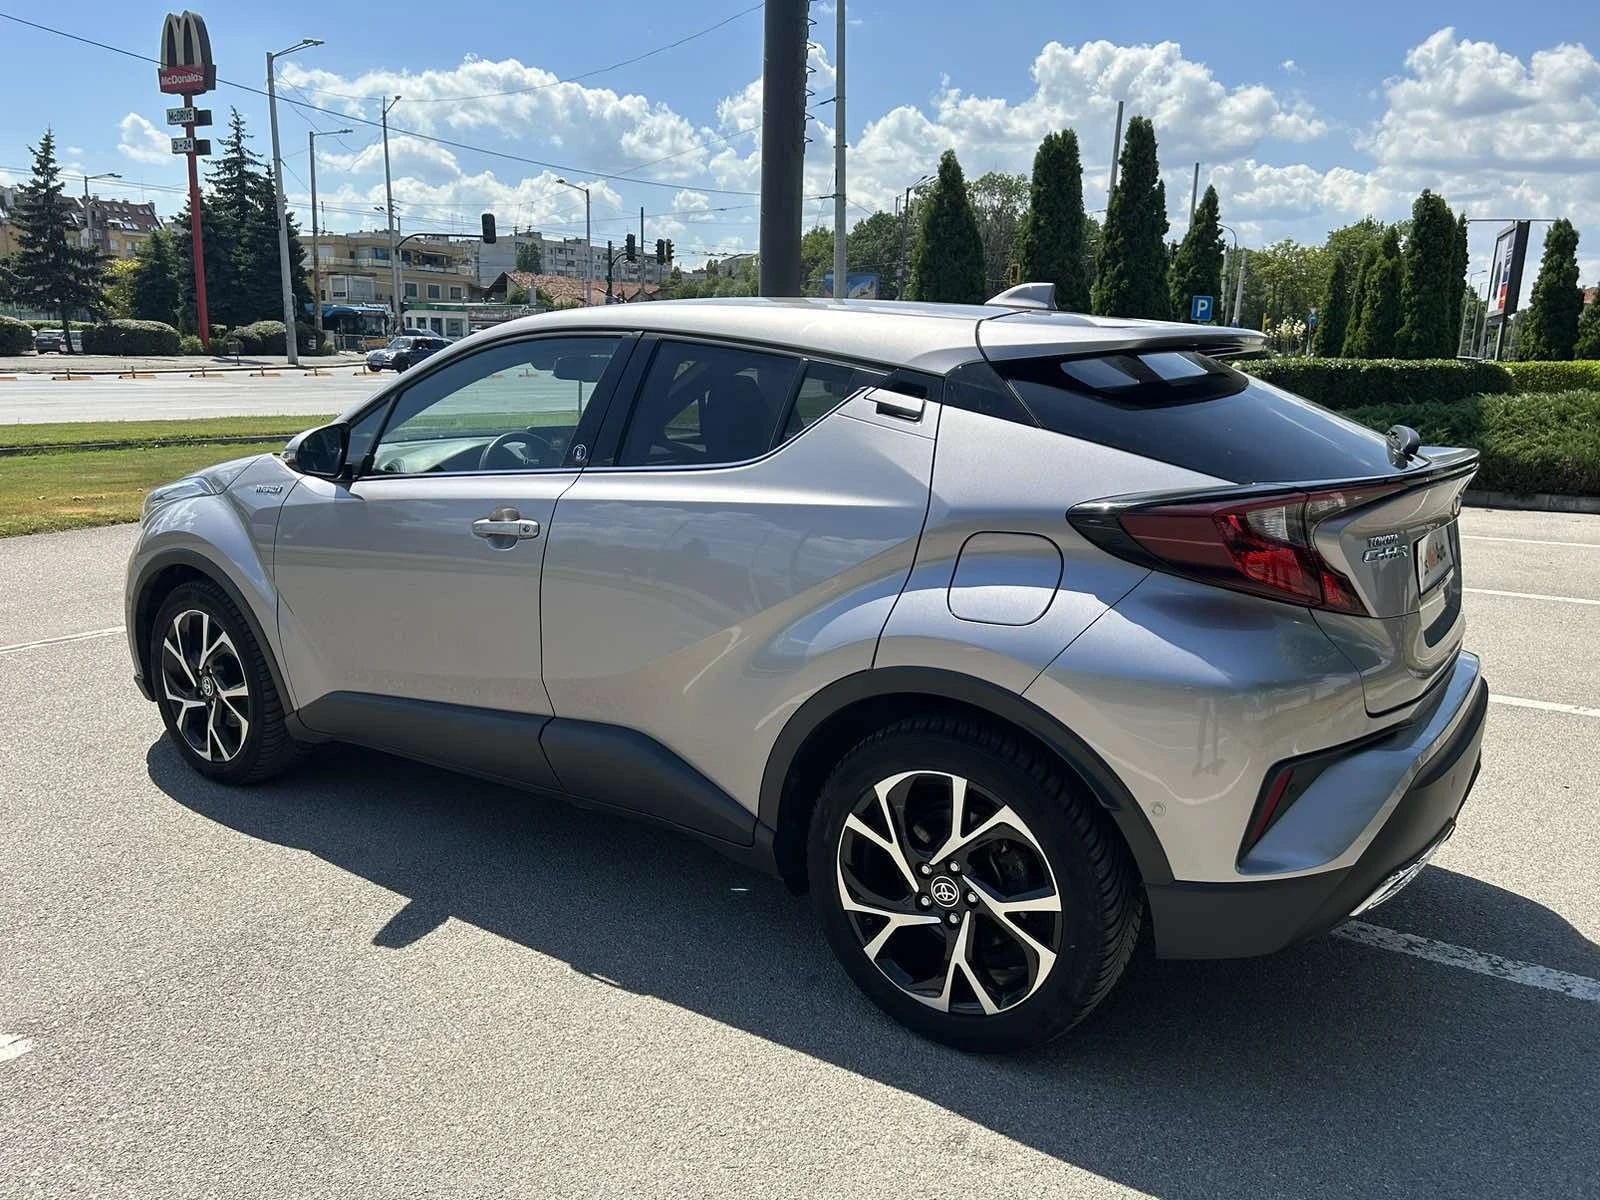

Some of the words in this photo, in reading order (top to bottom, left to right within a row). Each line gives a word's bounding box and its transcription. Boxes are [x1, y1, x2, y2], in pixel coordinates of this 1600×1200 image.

[168, 109, 193, 122] McDRIVE
[1196, 299, 1209, 317] P
[1368, 533, 1400, 548] TOYOTA
[1362, 545, 1409, 563] C-HR
